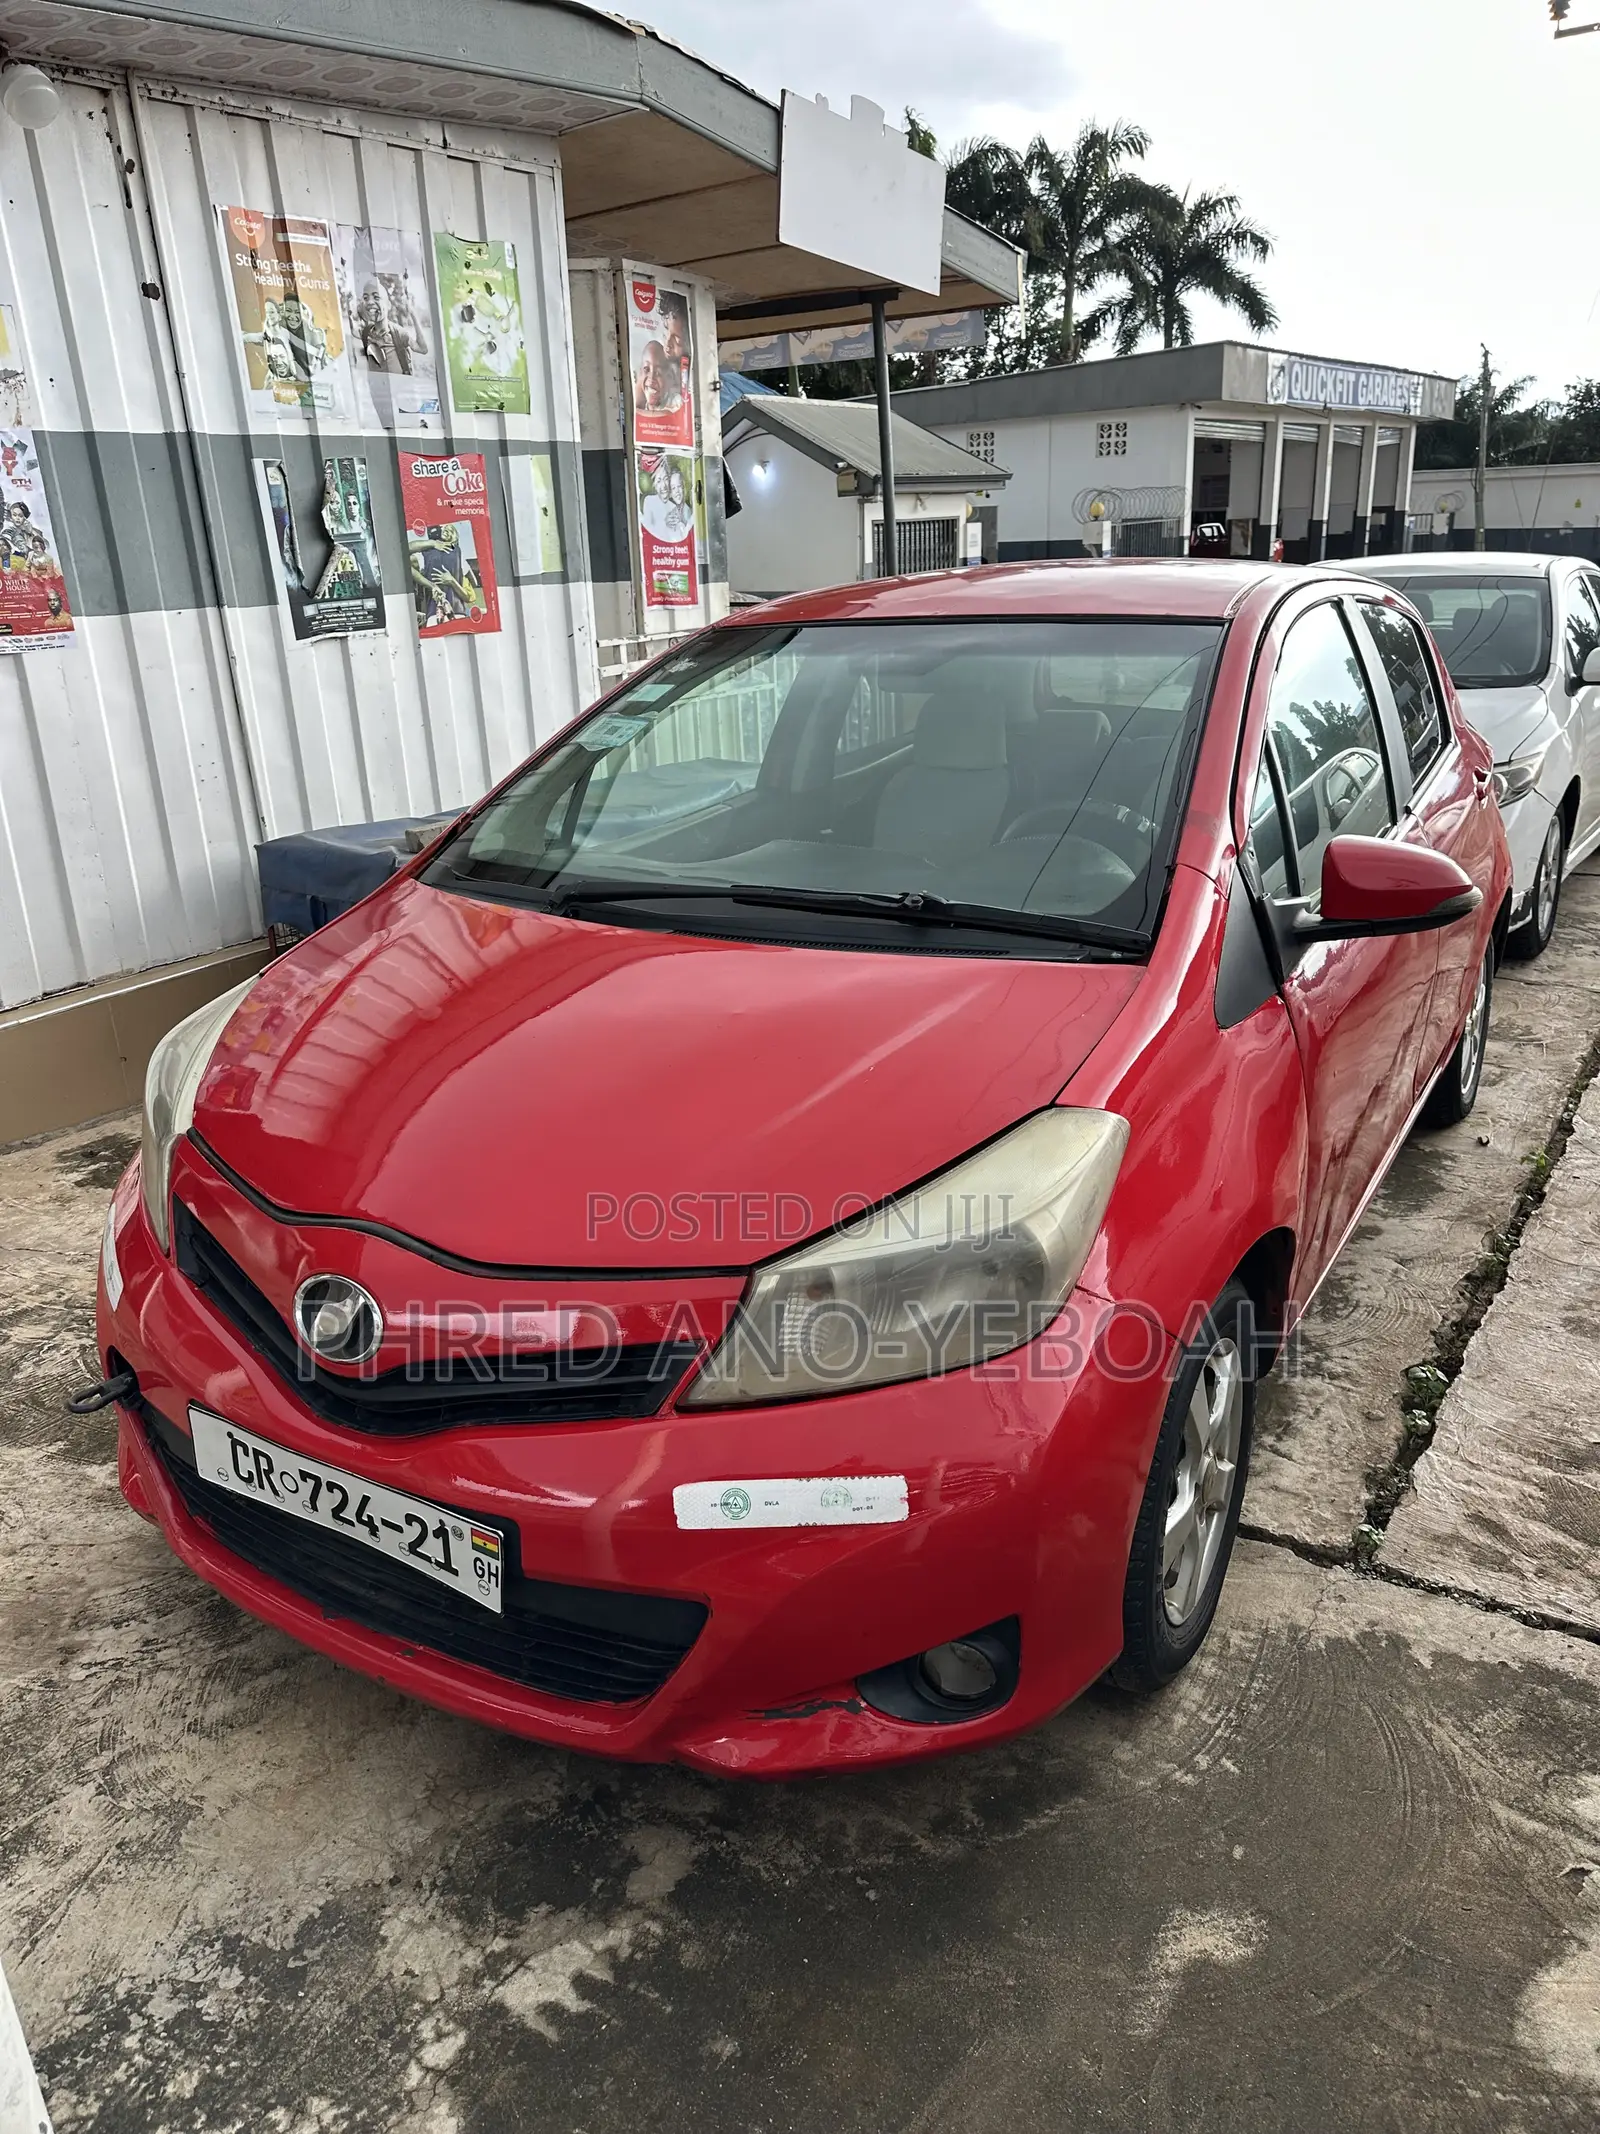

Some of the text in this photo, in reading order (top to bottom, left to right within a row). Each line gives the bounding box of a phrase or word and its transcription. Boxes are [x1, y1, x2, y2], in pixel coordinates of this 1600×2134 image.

[254, 272, 296, 292] Healthy
[1291, 362, 1356, 405] QUICKFIT
[1357, 372, 1411, 408] GARAGES
[413, 459, 460, 475] share a
[444, 469, 484, 494] Coke
[436, 498, 442, 506] &
[652, 545, 674, 557] Strong
[652, 557, 676, 568] healthy
[4, 579, 29, 587] WHITE
[230, 1434, 459, 1577] CR 724-21
[473, 1556, 500, 1589] GH
